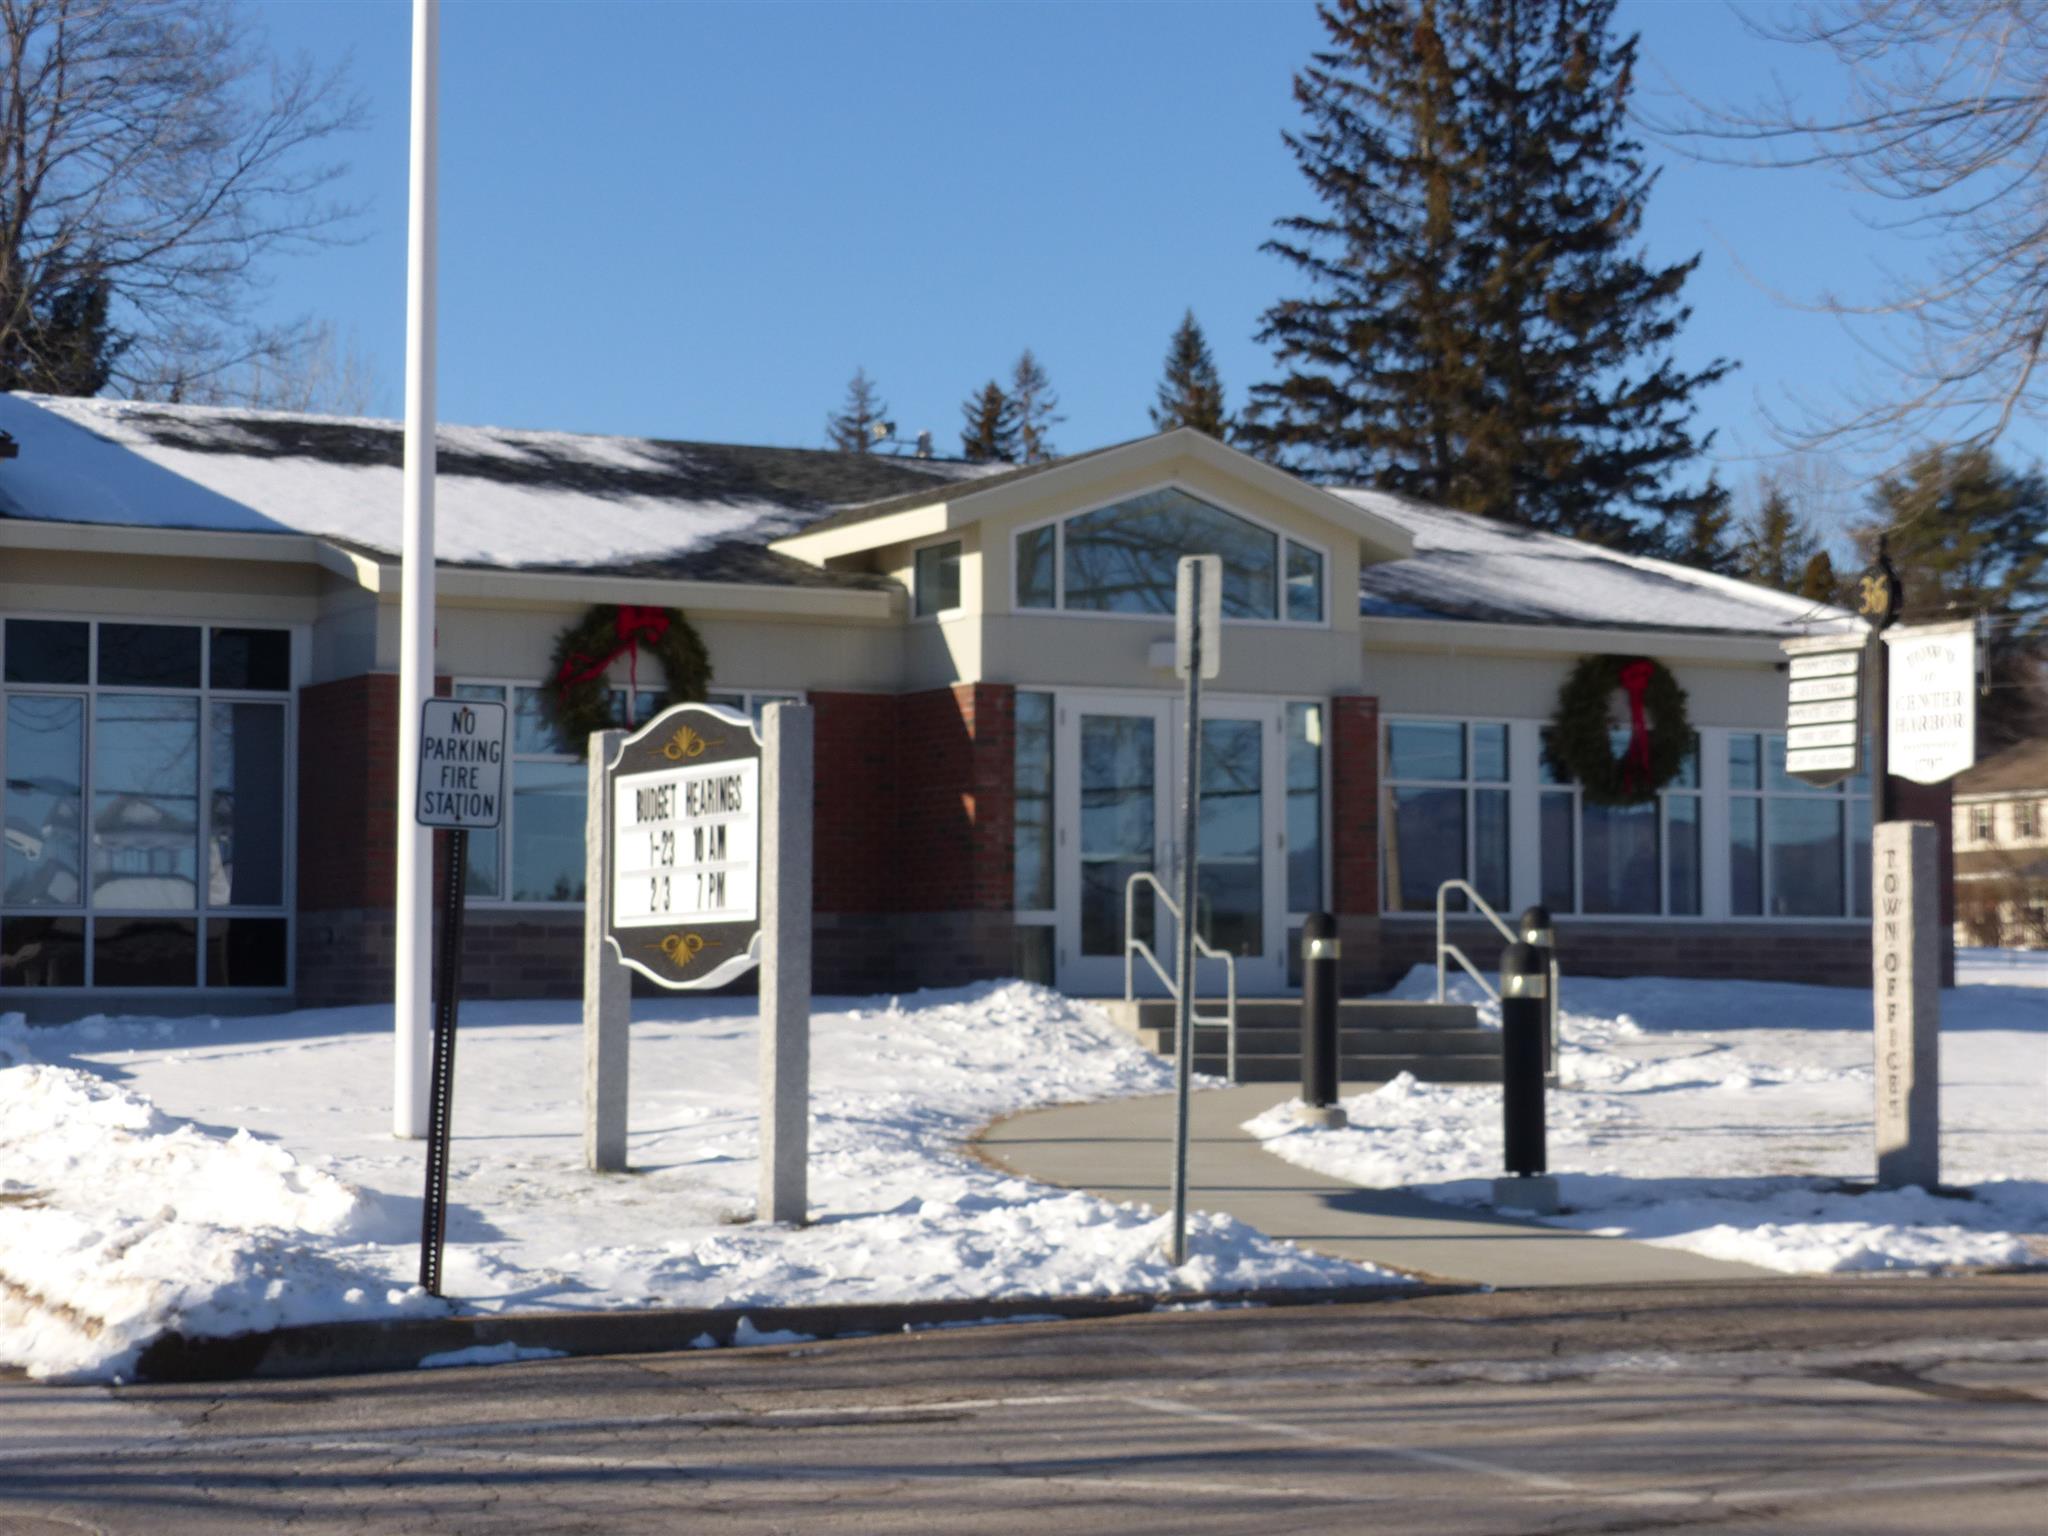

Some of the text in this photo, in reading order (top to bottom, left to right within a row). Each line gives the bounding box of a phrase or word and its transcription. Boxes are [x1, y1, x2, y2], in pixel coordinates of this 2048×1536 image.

[1858, 575, 1888, 614] 36
[1895, 690, 1966, 711] CENTER
[451, 711, 476, 735] NO
[1895, 712, 1967, 734] HARBOR
[423, 737, 500, 764] PARKING
[440, 765, 480, 790] FIRE
[424, 791, 495, 818] STATION
[636, 774, 743, 823] BUDGET HEARINGS
[649, 824, 727, 867] 1-23 10 AM
[708, 871, 726, 908] PM
[1882, 848, 1902, 942] TOWN
